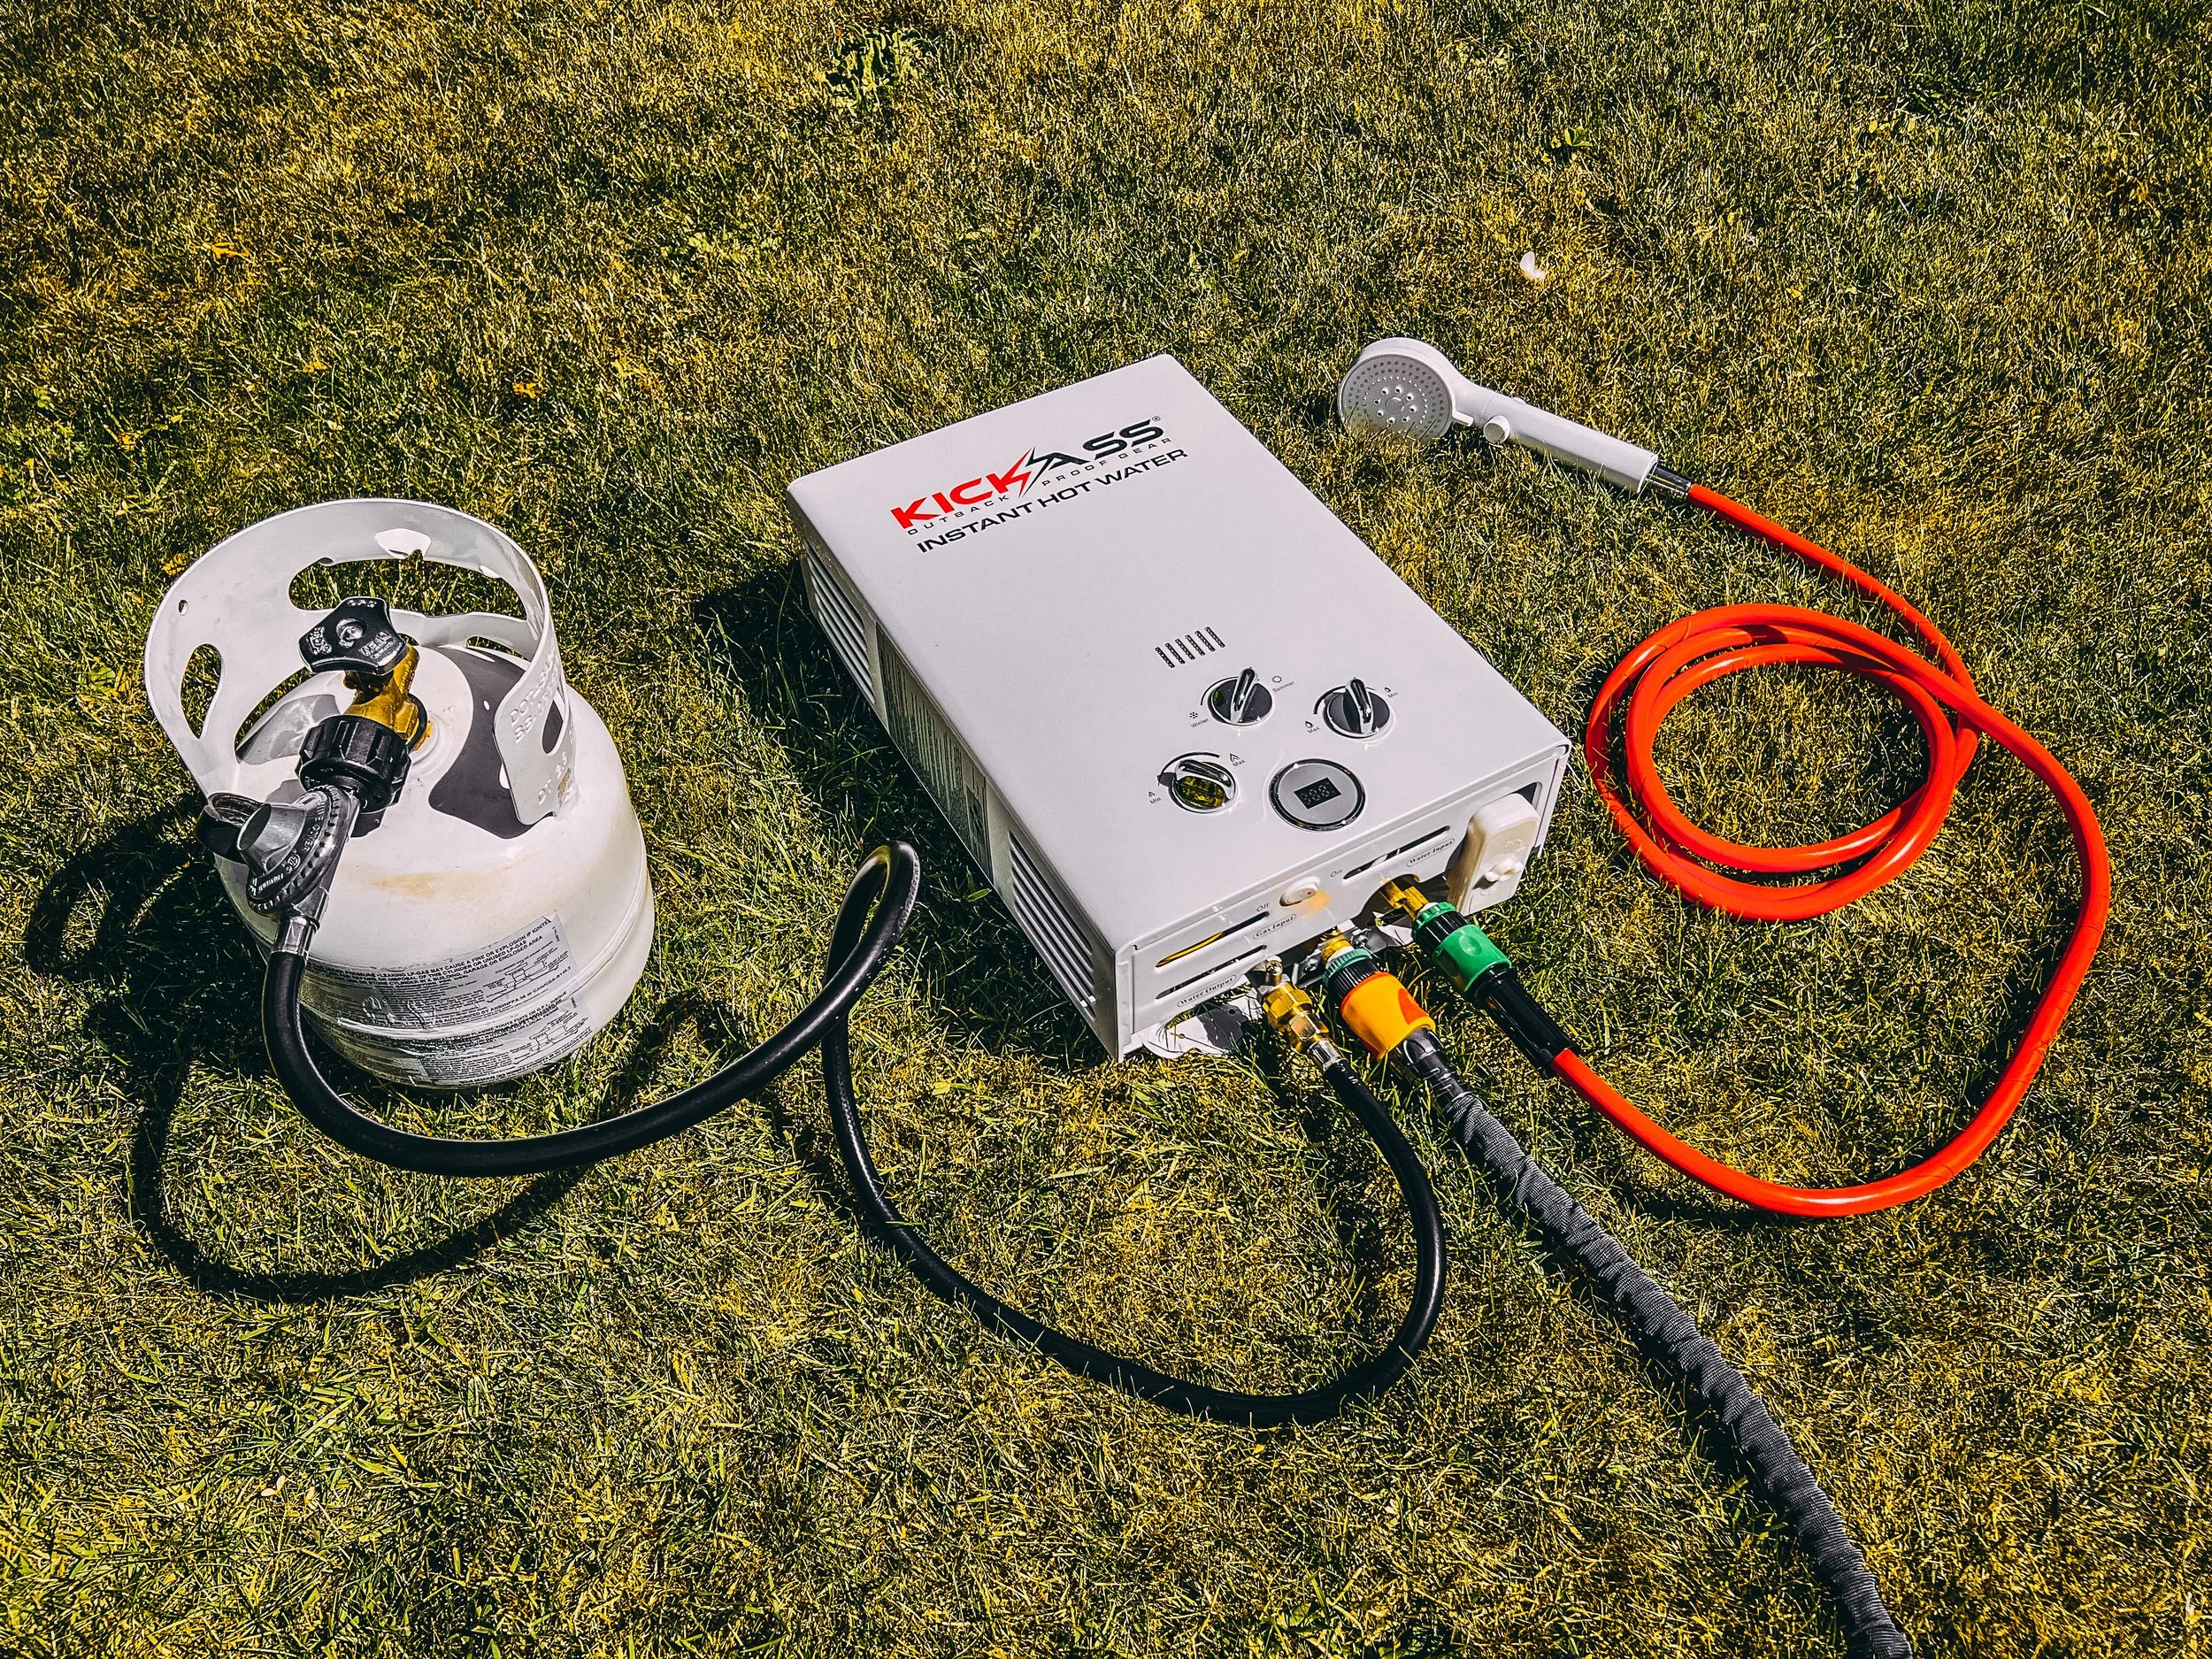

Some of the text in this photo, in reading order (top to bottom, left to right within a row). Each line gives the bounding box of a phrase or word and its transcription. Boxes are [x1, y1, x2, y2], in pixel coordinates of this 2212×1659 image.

[908, 437, 1171, 535] OUTBACK PROOF GEAR
[917, 449, 1188, 553] INSTANT HOT WATER
[1190, 717, 1210, 729] Winter
[1233, 758, 1246, 767] Max
[1409, 840, 1454, 865] Water Input
[1330, 869, 1343, 878] On
[1256, 902, 1270, 912] Off
[495, 935, 526, 953] EXPLOSION
[532, 920, 552, 933] IGNITE
[1256, 916, 1294, 937] Gas Input
[442, 964, 472, 975] CYLINDER
[483, 951, 506, 963] UNUSED
[507, 940, 526, 953] LP-GAS
[463, 964, 488, 974] GARAGE
[498, 945, 527, 962] ENCLOSED
[528, 935, 542, 947] AREA
[1180, 978, 1233, 1004] Water Output
[444, 1011, 480, 1022] AUTHORIZED
